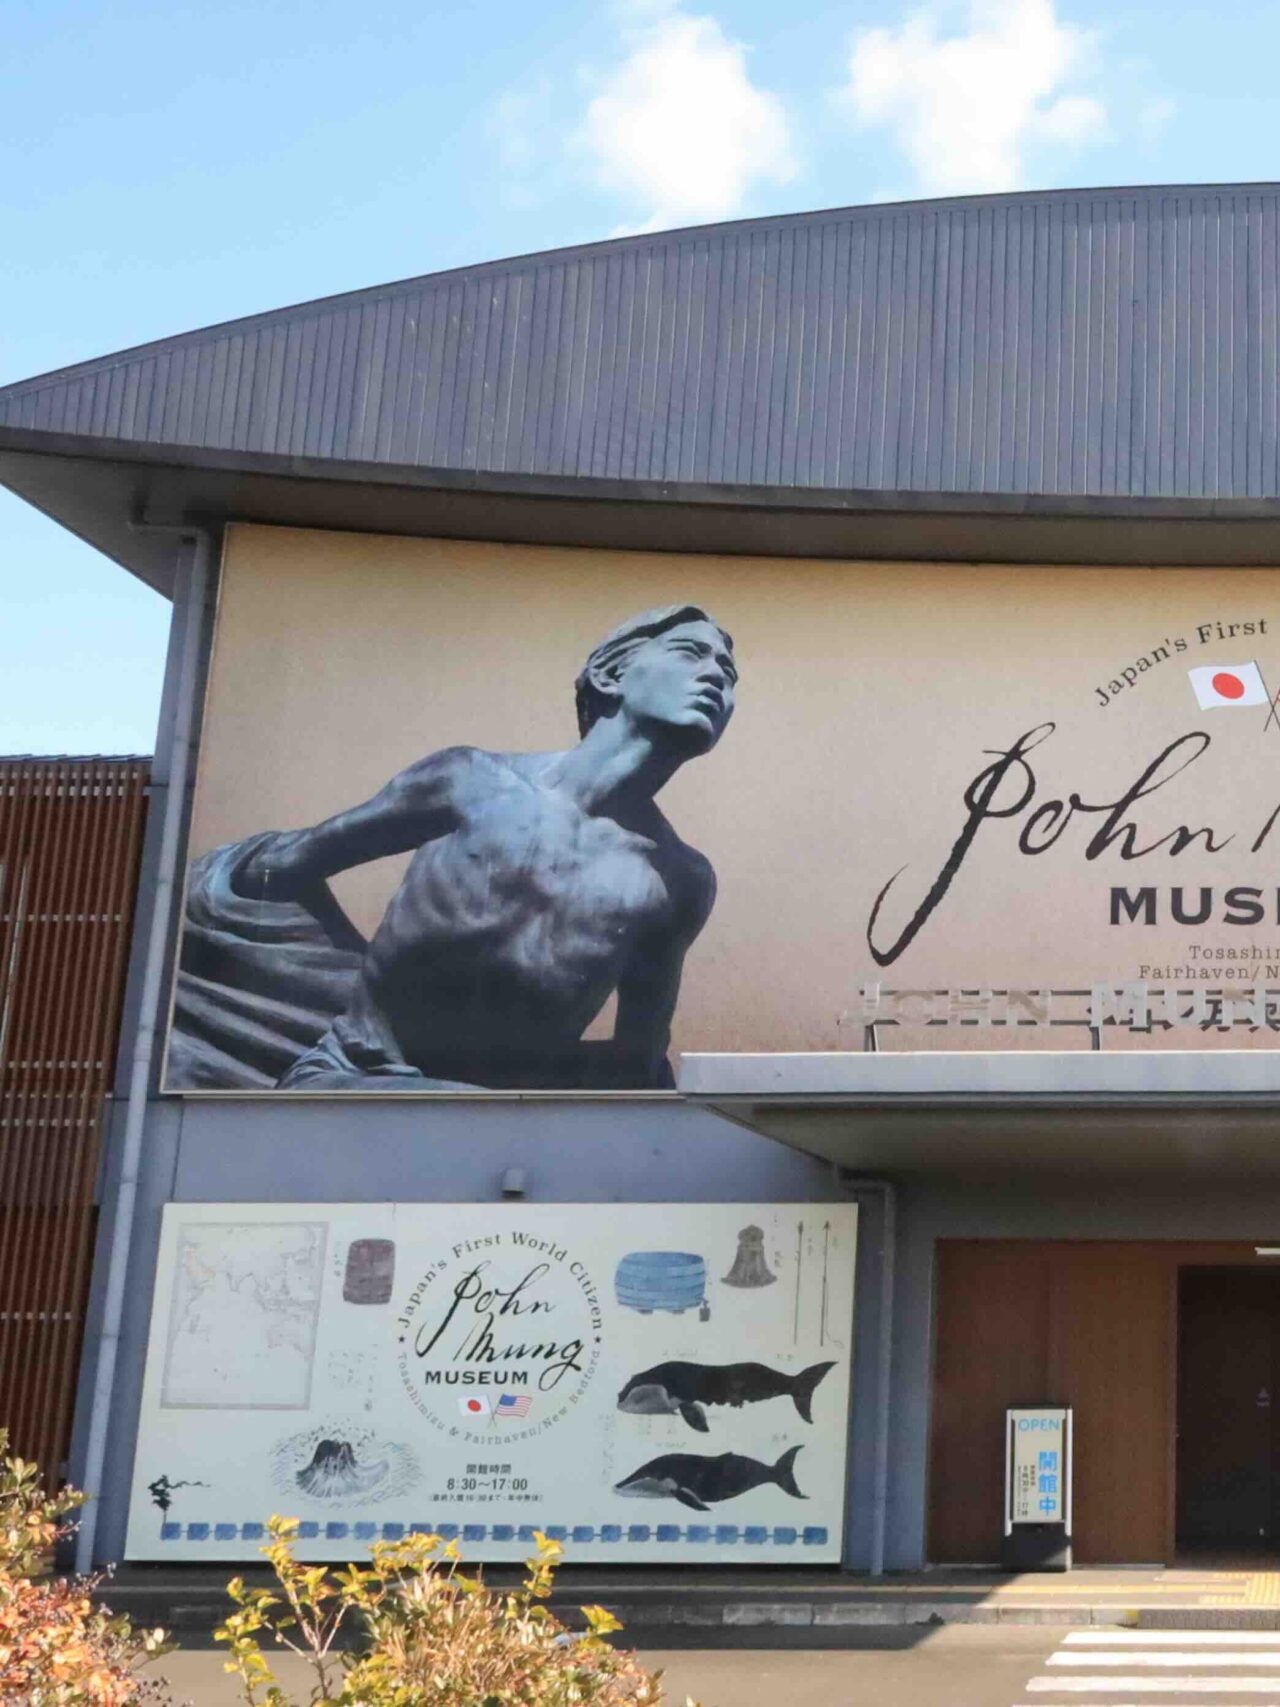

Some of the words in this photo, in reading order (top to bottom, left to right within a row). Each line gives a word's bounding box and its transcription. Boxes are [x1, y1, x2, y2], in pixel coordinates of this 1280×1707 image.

[1094, 638, 1189, 707] Japan's
[1196, 617, 1268, 644] First
[867, 722, 1234, 967] John
[398, 1259, 448, 1328] Japan's
[452, 1234, 501, 1259] First
[511, 1231, 568, 1262] World
[569, 1262, 603, 1329] Citizen
[415, 1260, 556, 1357] John
[425, 1370, 529, 1385] MUSEUM
[453, 1312, 584, 1391] Mung
[1018, 1418, 1060, 1432] OPEN
[466, 1464, 512, 1475] 開館時間
[1039, 1451, 1057, 1516] 開館中
